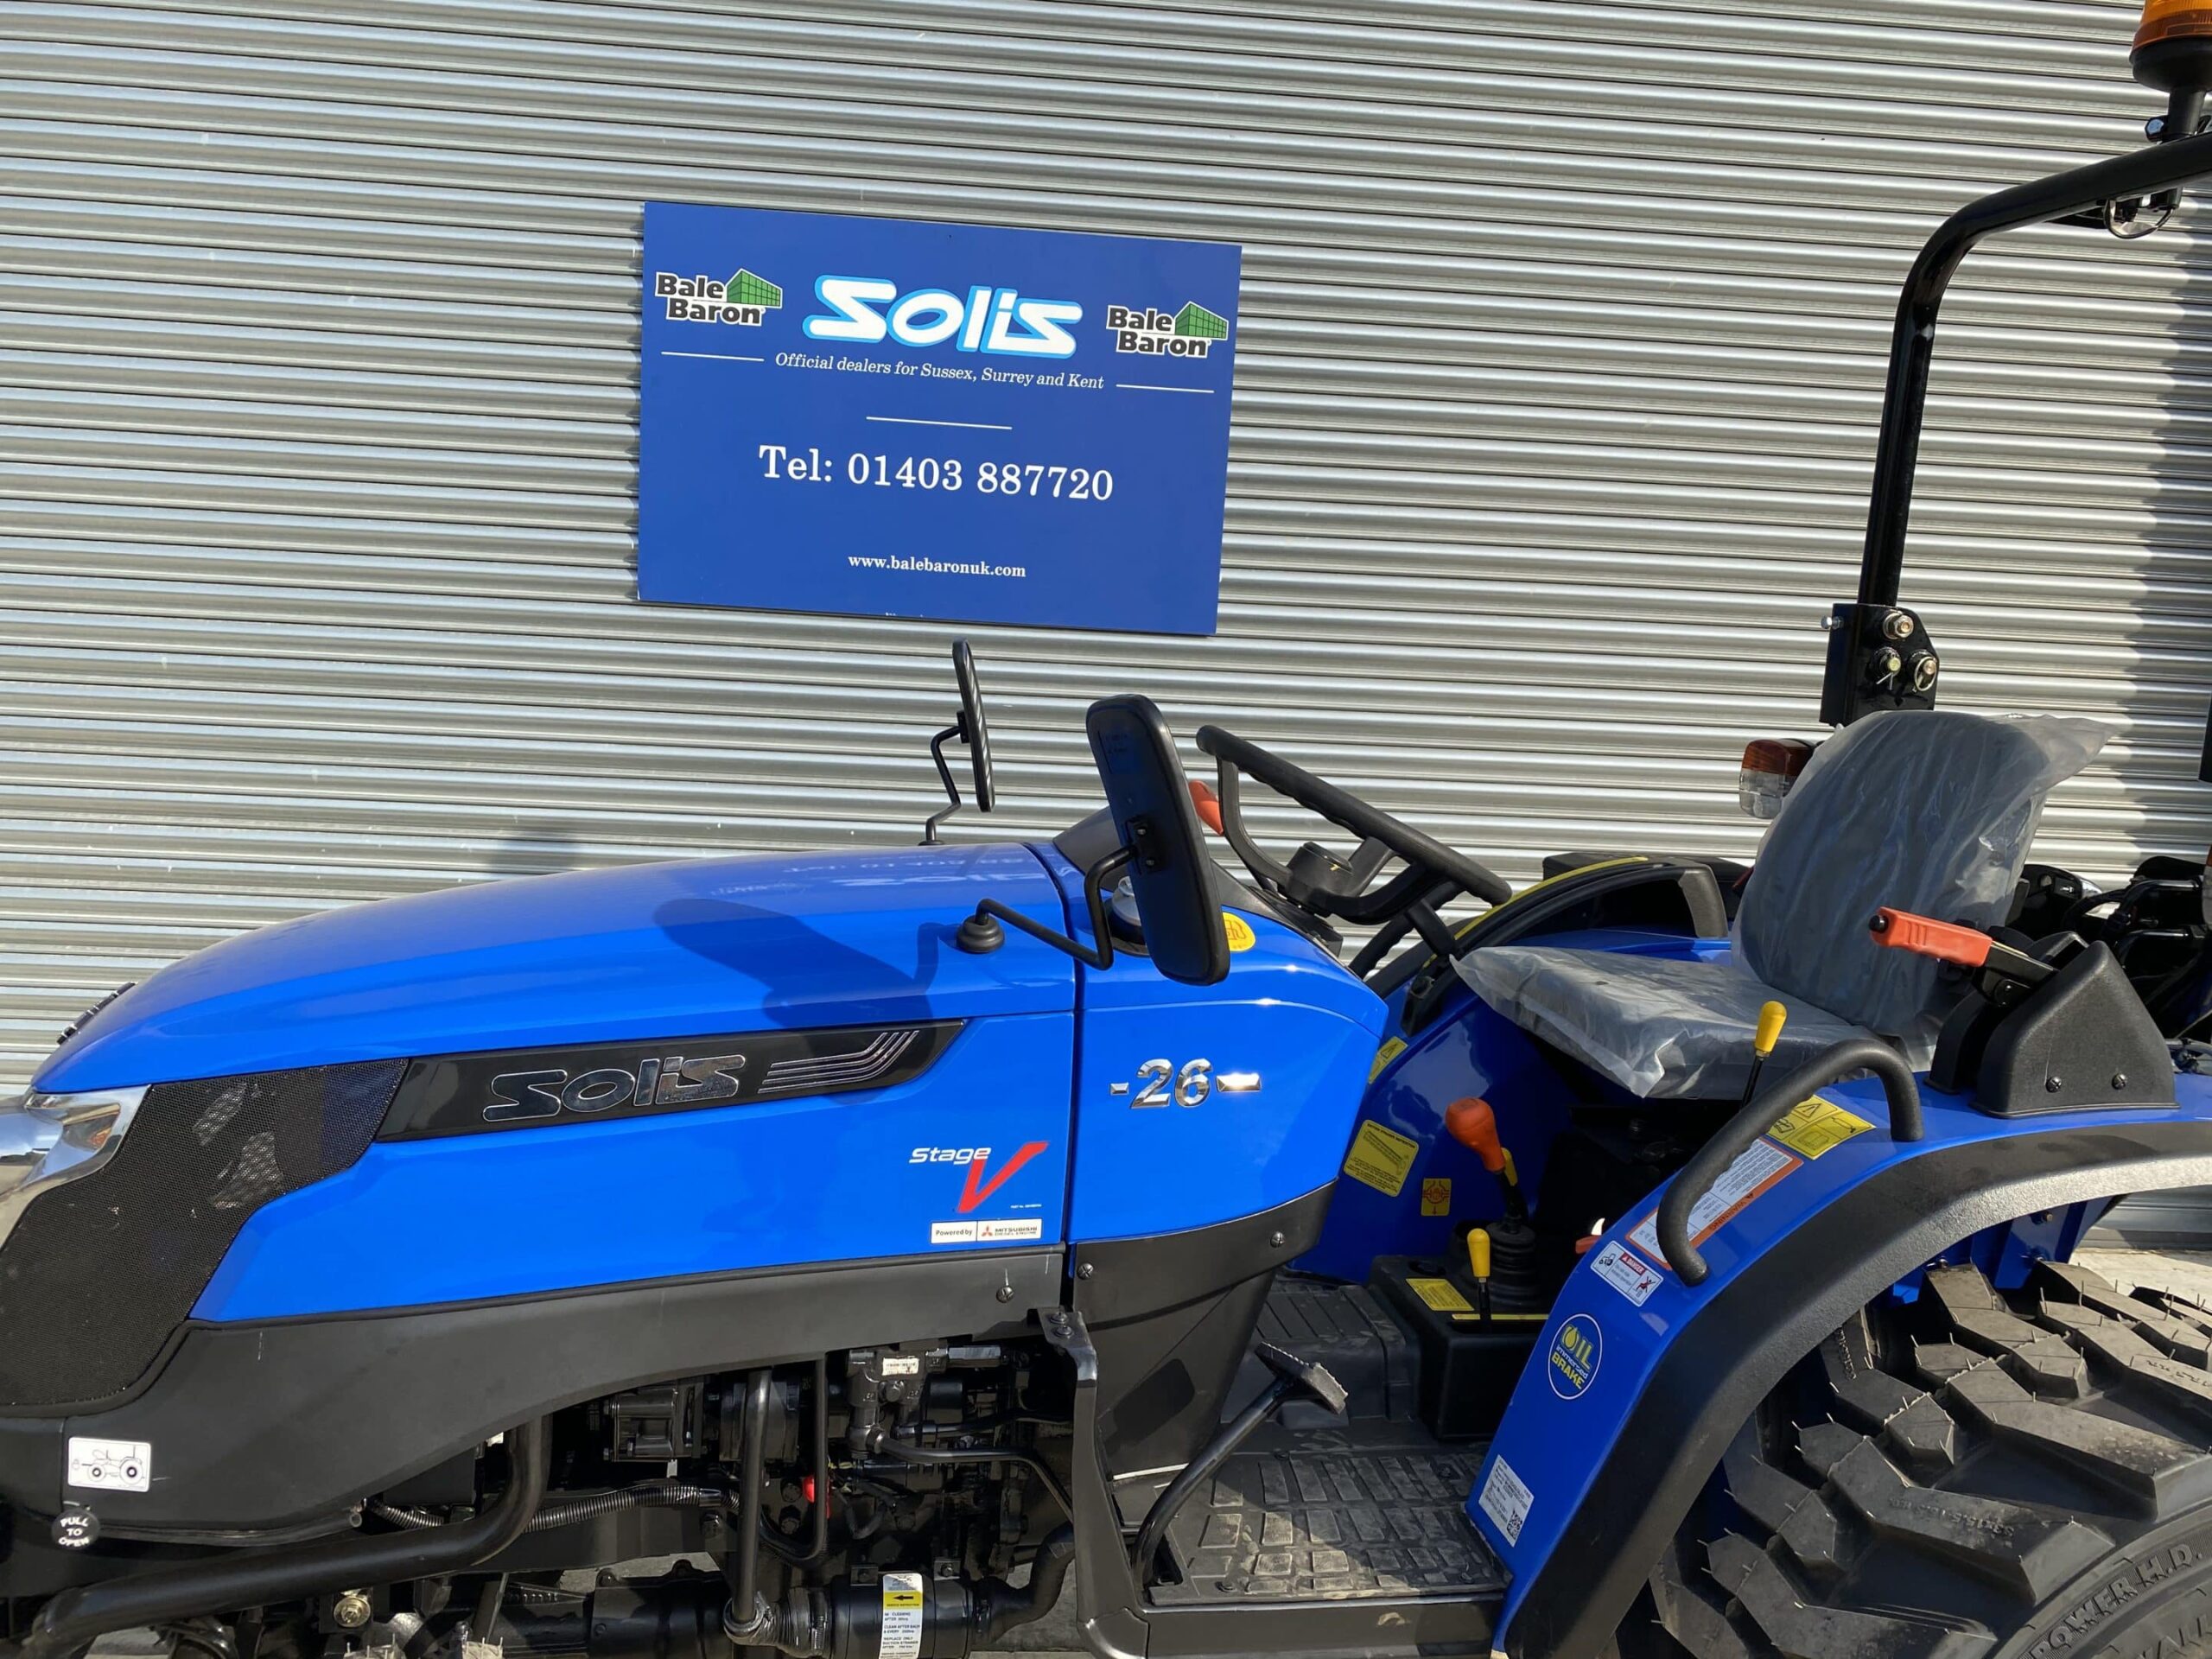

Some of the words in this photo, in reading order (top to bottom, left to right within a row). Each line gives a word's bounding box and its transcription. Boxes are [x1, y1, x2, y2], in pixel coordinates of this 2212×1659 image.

[656, 273, 724, 299] Bale
[668, 298, 761, 324] Baron
[802, 275, 1083, 359] Solis
[1108, 307, 1173, 332] Bale
[1118, 330, 1207, 356] Baron
[775, 353, 834, 371] Official
[837, 359, 892, 375] dealers
[893, 361, 918, 378] for
[920, 363, 977, 382] Sussex,
[982, 368, 1034, 386] Surrey
[1037, 373, 1065, 387] and
[1068, 374, 1105, 389] Kent
[758, 444, 833, 482] Tel:
[848, 453, 963, 491] 01403
[976, 462, 1114, 501] 887720
[848, 555, 1027, 577] www.balebaronuk.com
[909, 1147, 992, 1165] Stage
[957, 1141, 1049, 1213] V
[1628, 1256, 1645, 1275] DANGER
[1561, 1325, 1592, 1370] OIL
[1551, 1351, 1586, 1390] BRAKE
[60, 1516, 88, 1528] PULL
[67, 1528, 83, 1536] TO
[58, 1536, 90, 1547] OPEN
[2029, 1576, 2139, 1659] POWER
